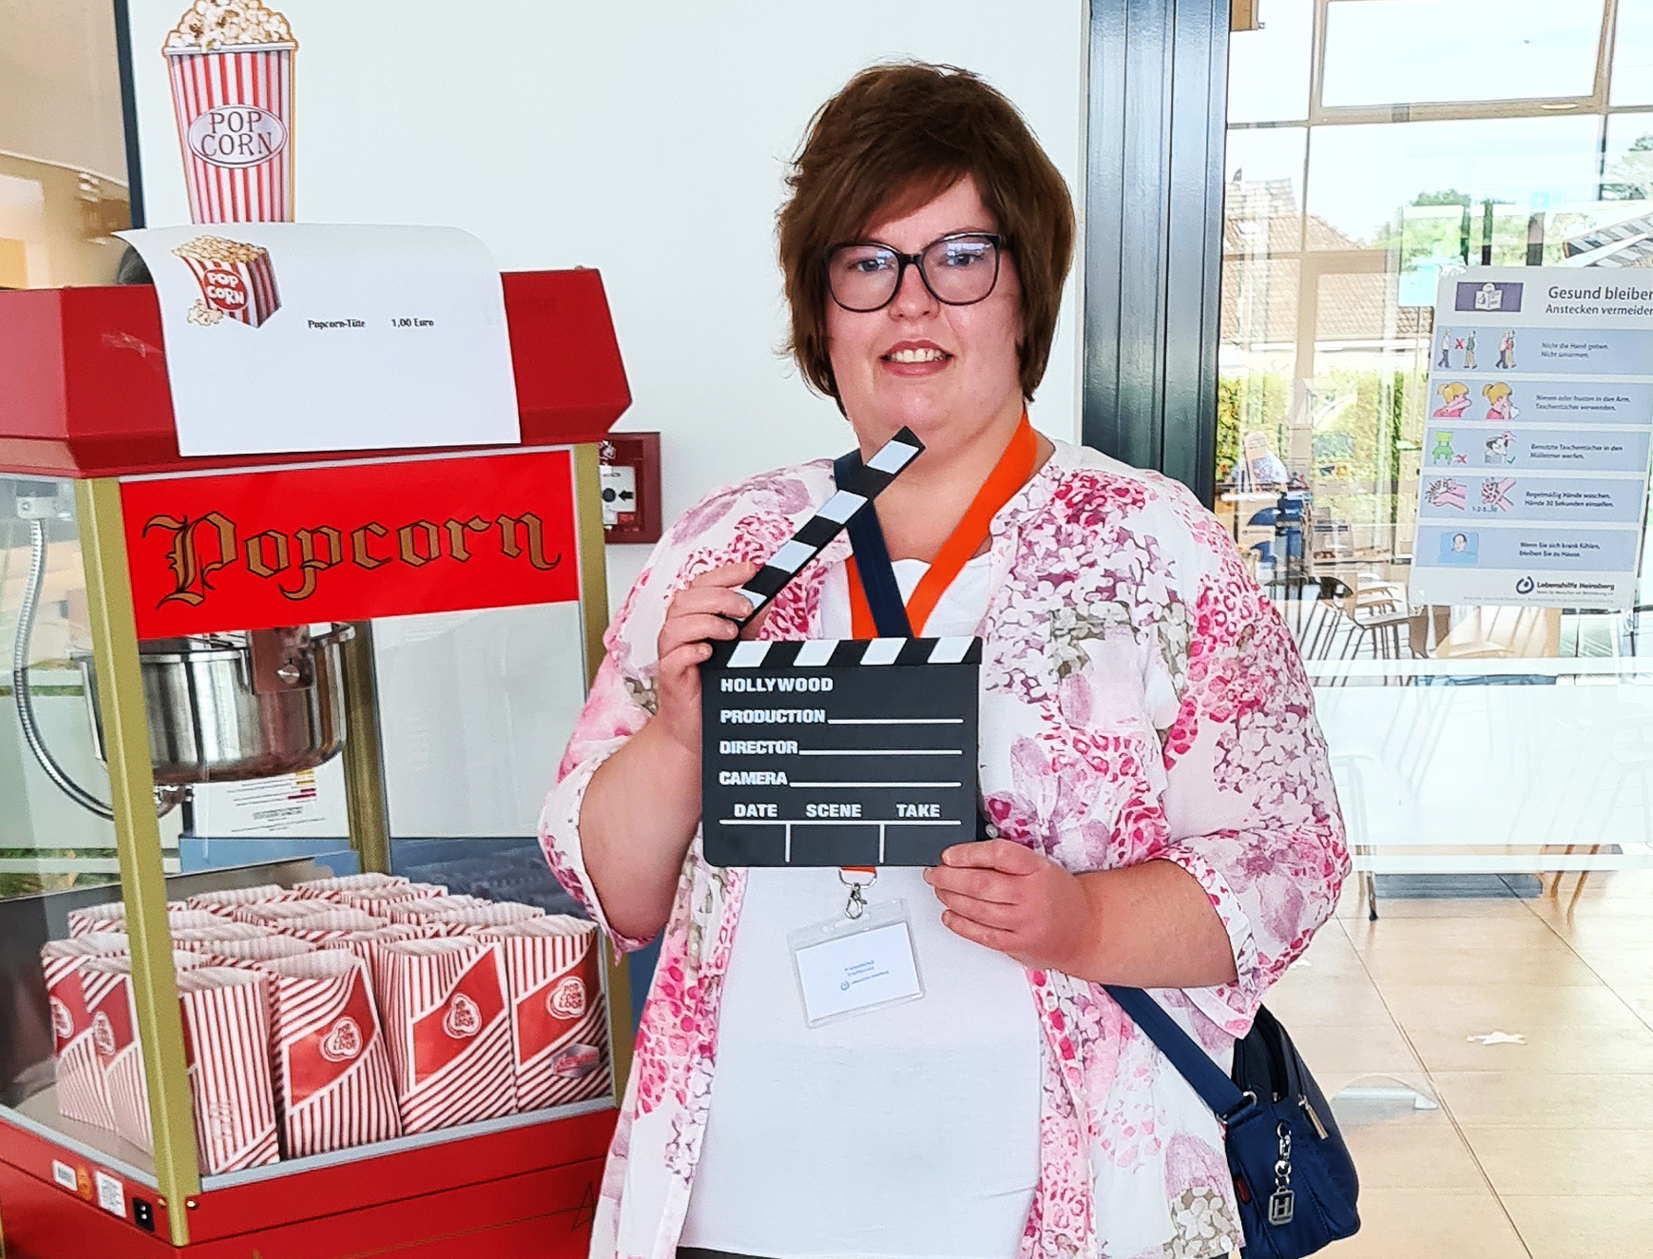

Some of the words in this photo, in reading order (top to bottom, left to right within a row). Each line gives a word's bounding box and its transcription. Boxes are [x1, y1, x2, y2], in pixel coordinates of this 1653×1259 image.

[210, 111, 261, 133] POP
[201, 132, 272, 156] CORN
[206, 272, 239, 288] POP
[207, 285, 245, 305] CORN
[1548, 286, 1602, 300] Gesund
[1545, 304, 1599, 314] Anstecken
[392, 318, 412, 328] 1,00
[414, 318, 434, 327] Euro
[142, 510, 562, 611] Popcorn
[1580, 582, 1615, 591] Heinsberg
[720, 678, 834, 692] HOLLYWOOD
[720, 709, 826, 724] PRODUCTION
[719, 740, 798, 754] DIRECTOR
[719, 771, 788, 786] CAMERA
[734, 804, 778, 818] DATE
[806, 804, 862, 818] SCENE
[896, 804, 941, 818] TAKE
